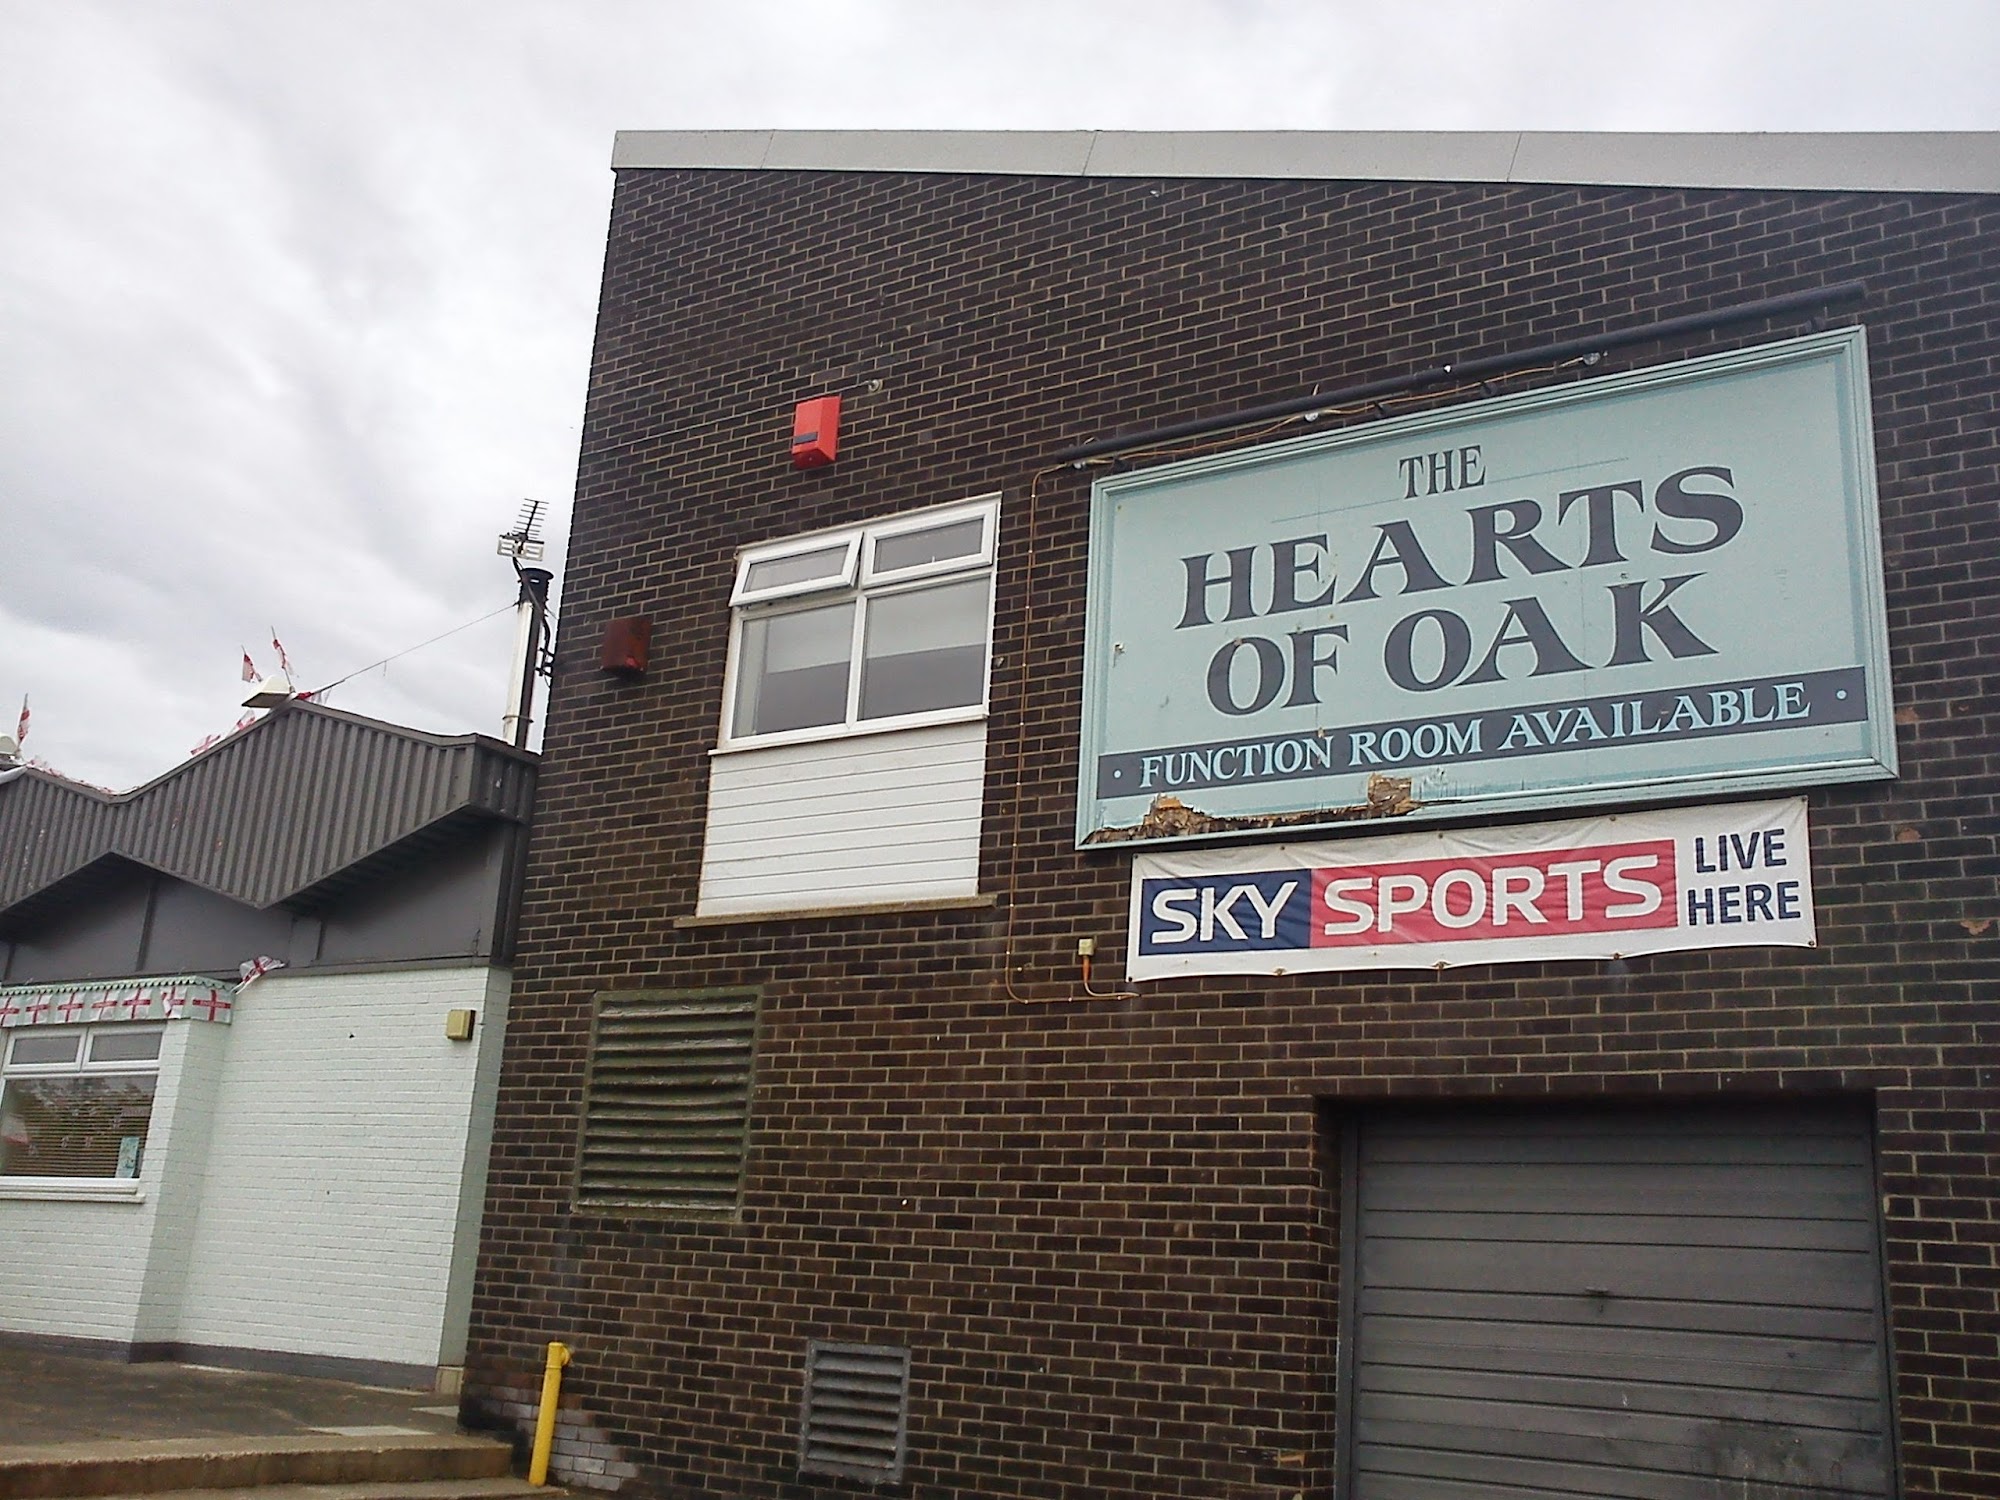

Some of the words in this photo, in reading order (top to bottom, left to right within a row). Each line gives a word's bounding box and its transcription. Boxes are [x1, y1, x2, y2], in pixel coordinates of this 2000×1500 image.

[1399, 444, 1487, 499] THE
[1174, 466, 1744, 630] HEARTS
[1206, 624, 1350, 716] OF
[1383, 571, 1720, 692] OAK
[1139, 736, 1332, 789] FUNCTION
[1349, 717, 1484, 767] ROOM
[1497, 681, 1812, 752] AVAILABLE
[1695, 828, 1787, 873] LIVE
[1151, 881, 1298, 944] SKY
[1324, 854, 1662, 935] SPORTS
[1687, 881, 1801, 926] HERE
